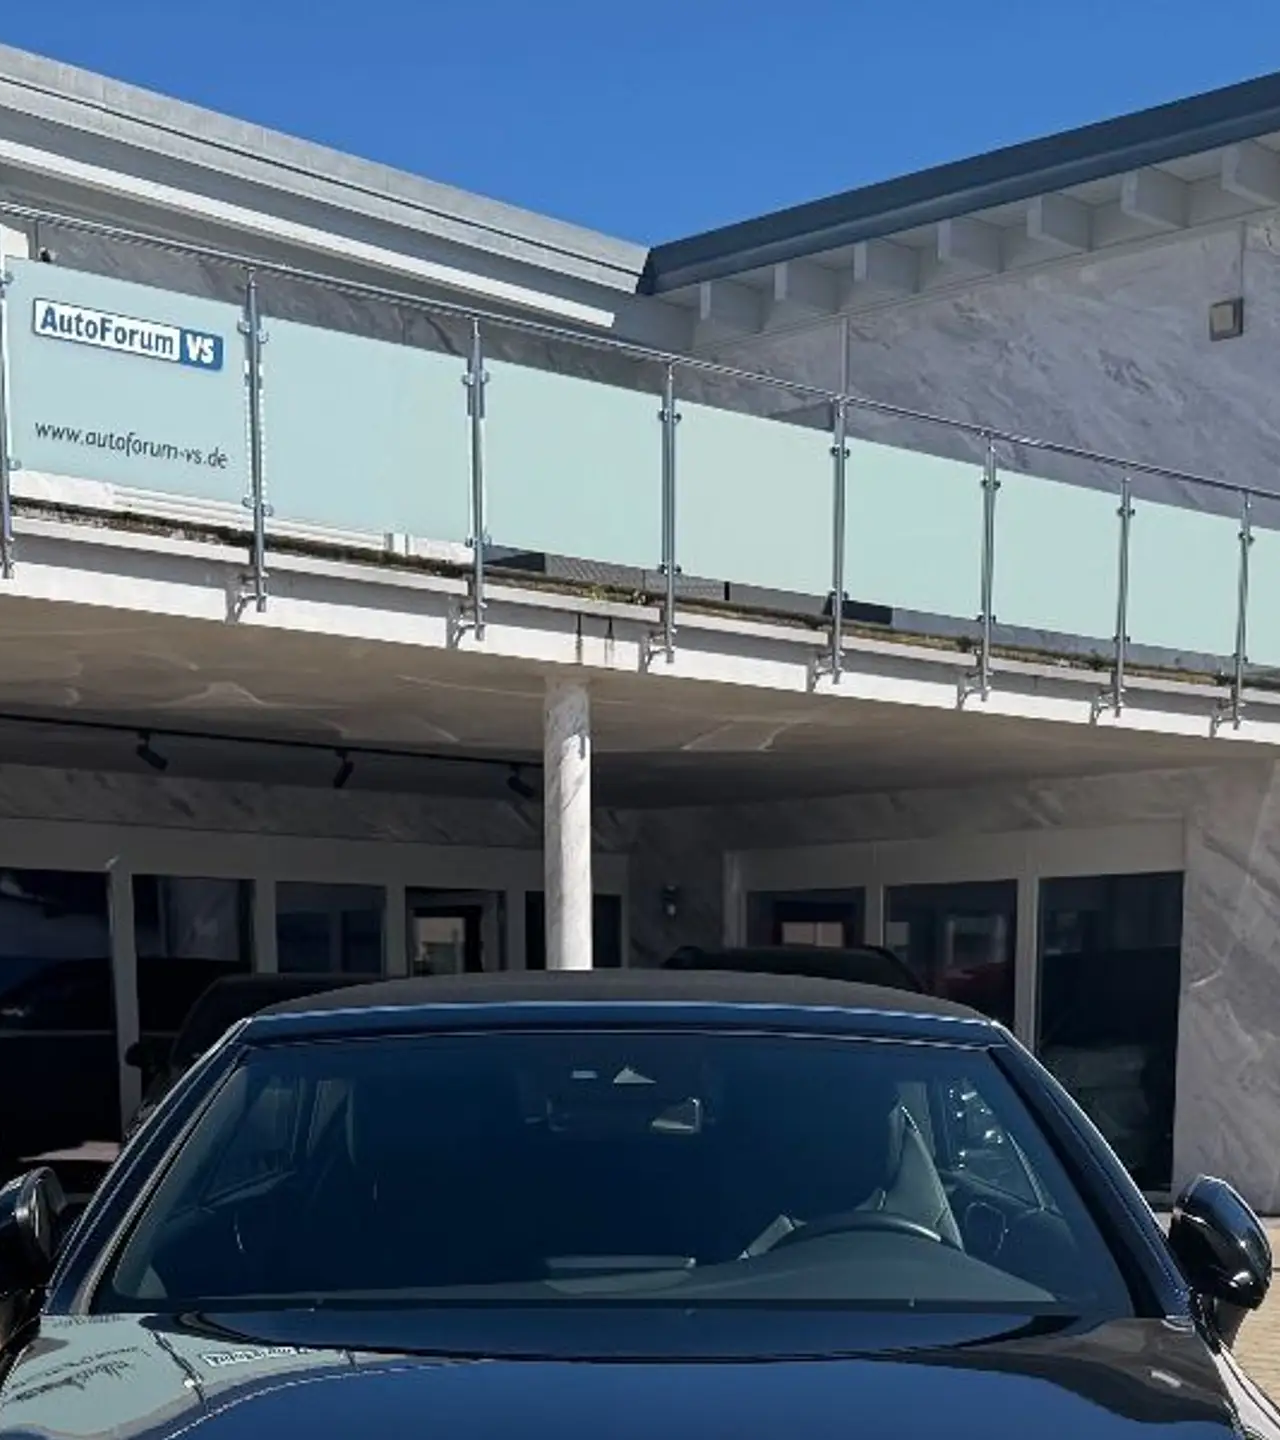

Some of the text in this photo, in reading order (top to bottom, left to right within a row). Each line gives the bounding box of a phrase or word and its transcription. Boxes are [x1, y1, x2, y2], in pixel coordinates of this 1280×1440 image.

[40, 305, 215, 364] AutoForum VS
[34, 421, 229, 469] www.autoforum-vs.de
